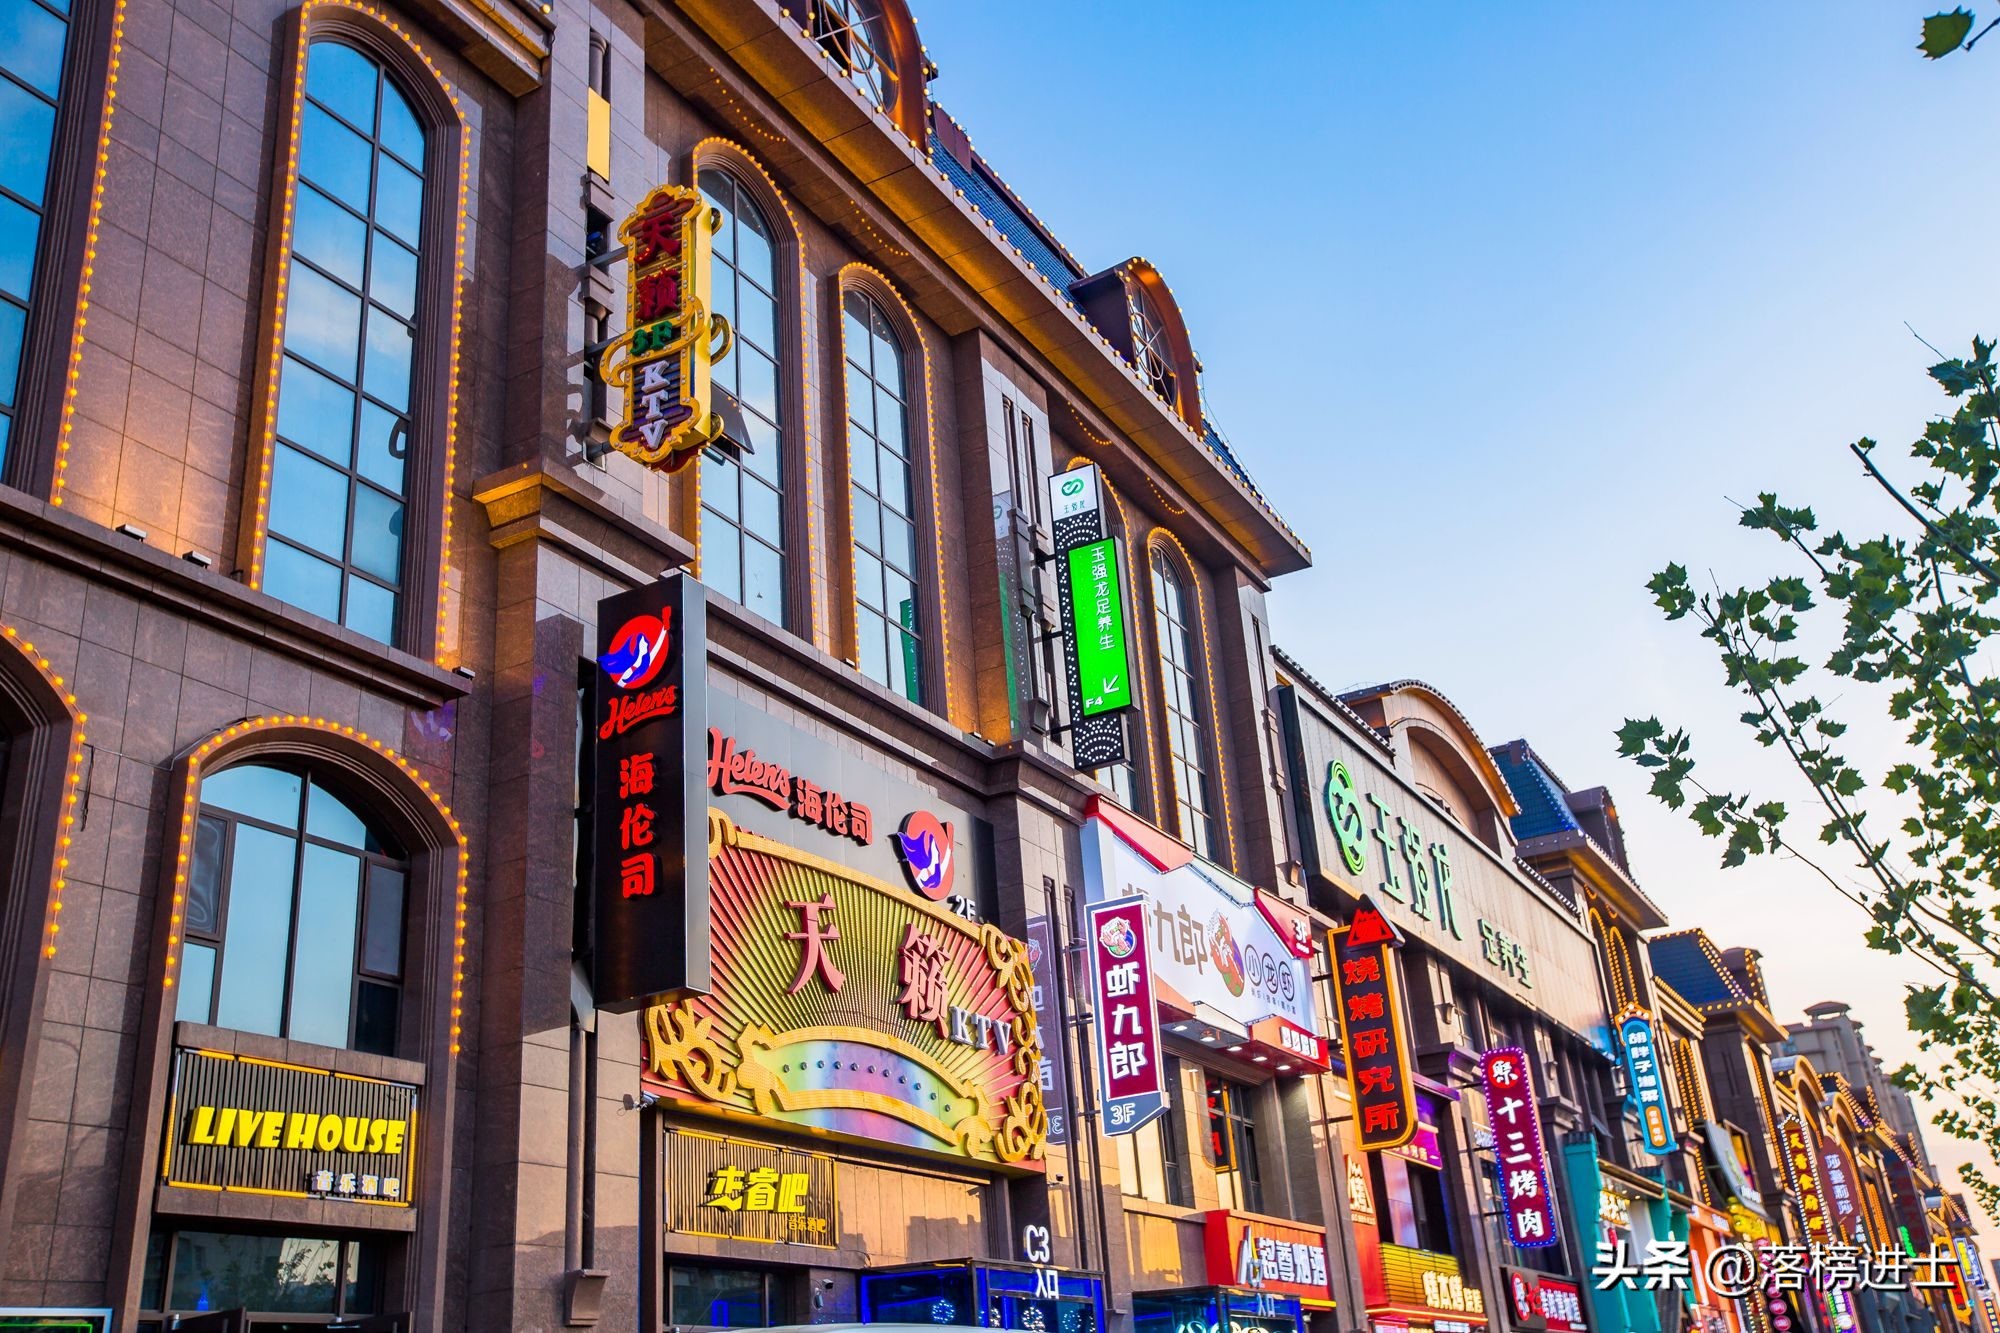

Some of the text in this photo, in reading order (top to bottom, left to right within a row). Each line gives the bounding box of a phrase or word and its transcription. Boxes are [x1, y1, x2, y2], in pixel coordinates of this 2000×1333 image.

[639, 359, 670, 449] KTV
[1086, 697, 1103, 708] F4
[620, 752, 655, 899] 海伦司
[796, 777, 873, 846] 海伦司
[955, 895, 976, 923] 2F
[1246, 946, 1295, 998] 小龙虾
[950, 1005, 1012, 1056] KTV
[1106, 961, 1149, 1080] 虾九郎
[1343, 955, 1399, 1134] 烧烤研究所
[189, 1106, 406, 1155] LIVE HOUSE
[1110, 1102, 1136, 1125] 3F
[313, 1169, 400, 1198] 音乐酒吧
[1027, 1224, 1050, 1263] C3
[1034, 1269, 1059, 1299] 入口
